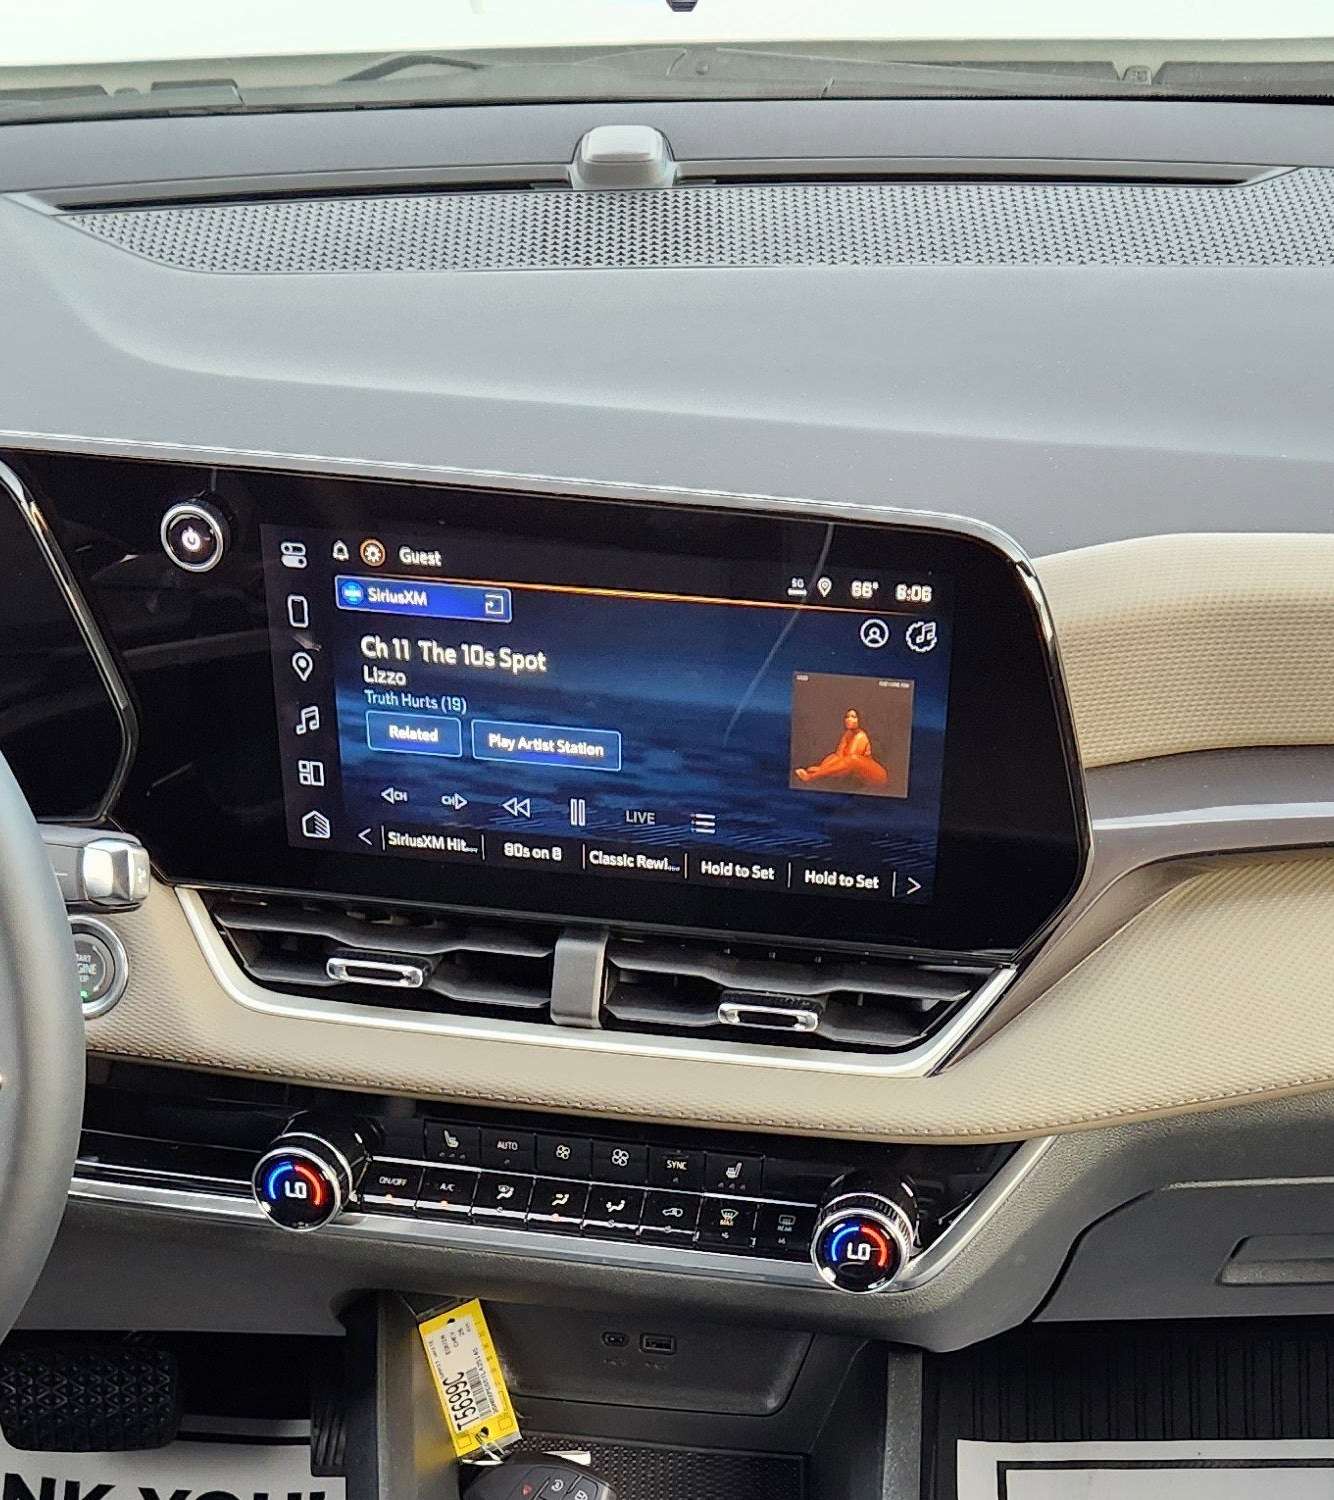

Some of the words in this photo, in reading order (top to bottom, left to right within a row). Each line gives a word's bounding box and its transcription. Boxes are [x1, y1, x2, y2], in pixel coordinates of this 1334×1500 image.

[399, 548, 441, 567] Guest
[368, 587, 427, 607] SiriusXM
[361, 635, 387, 660] Ch
[392, 638, 411, 661] 11
[418, 640, 456, 665] The
[461, 644, 494, 667] 10s
[499, 648, 547, 674] Spot
[364, 665, 406, 686] Lizzo
[364, 689, 398, 706] Truth
[401, 693, 438, 710] Hurts
[389, 725, 439, 742] Related
[489, 734, 515, 751] Play
[518, 736, 554, 752] Artist
[557, 740, 604, 757] Station
[626, 810, 656, 825] LIVE
[388, 831, 443, 850] SiriusXM
[532, 847, 549, 859] on
[589, 851, 634, 868] Classic
[701, 861, 733, 876] Hold
[735, 864, 749, 878] to
[752, 865, 775, 880] Set
[805, 870, 837, 885] Hold
[839, 873, 853, 887] to
[856, 875, 879, 889] Set
[497, 1140, 517, 1151] AUTO
[667, 1160, 687, 1170] SYNC
[379, 1176, 407, 1186] ON/OFF
[440, 1182, 455, 1192] A/C
[442, 1371, 480, 1431] T5699C
